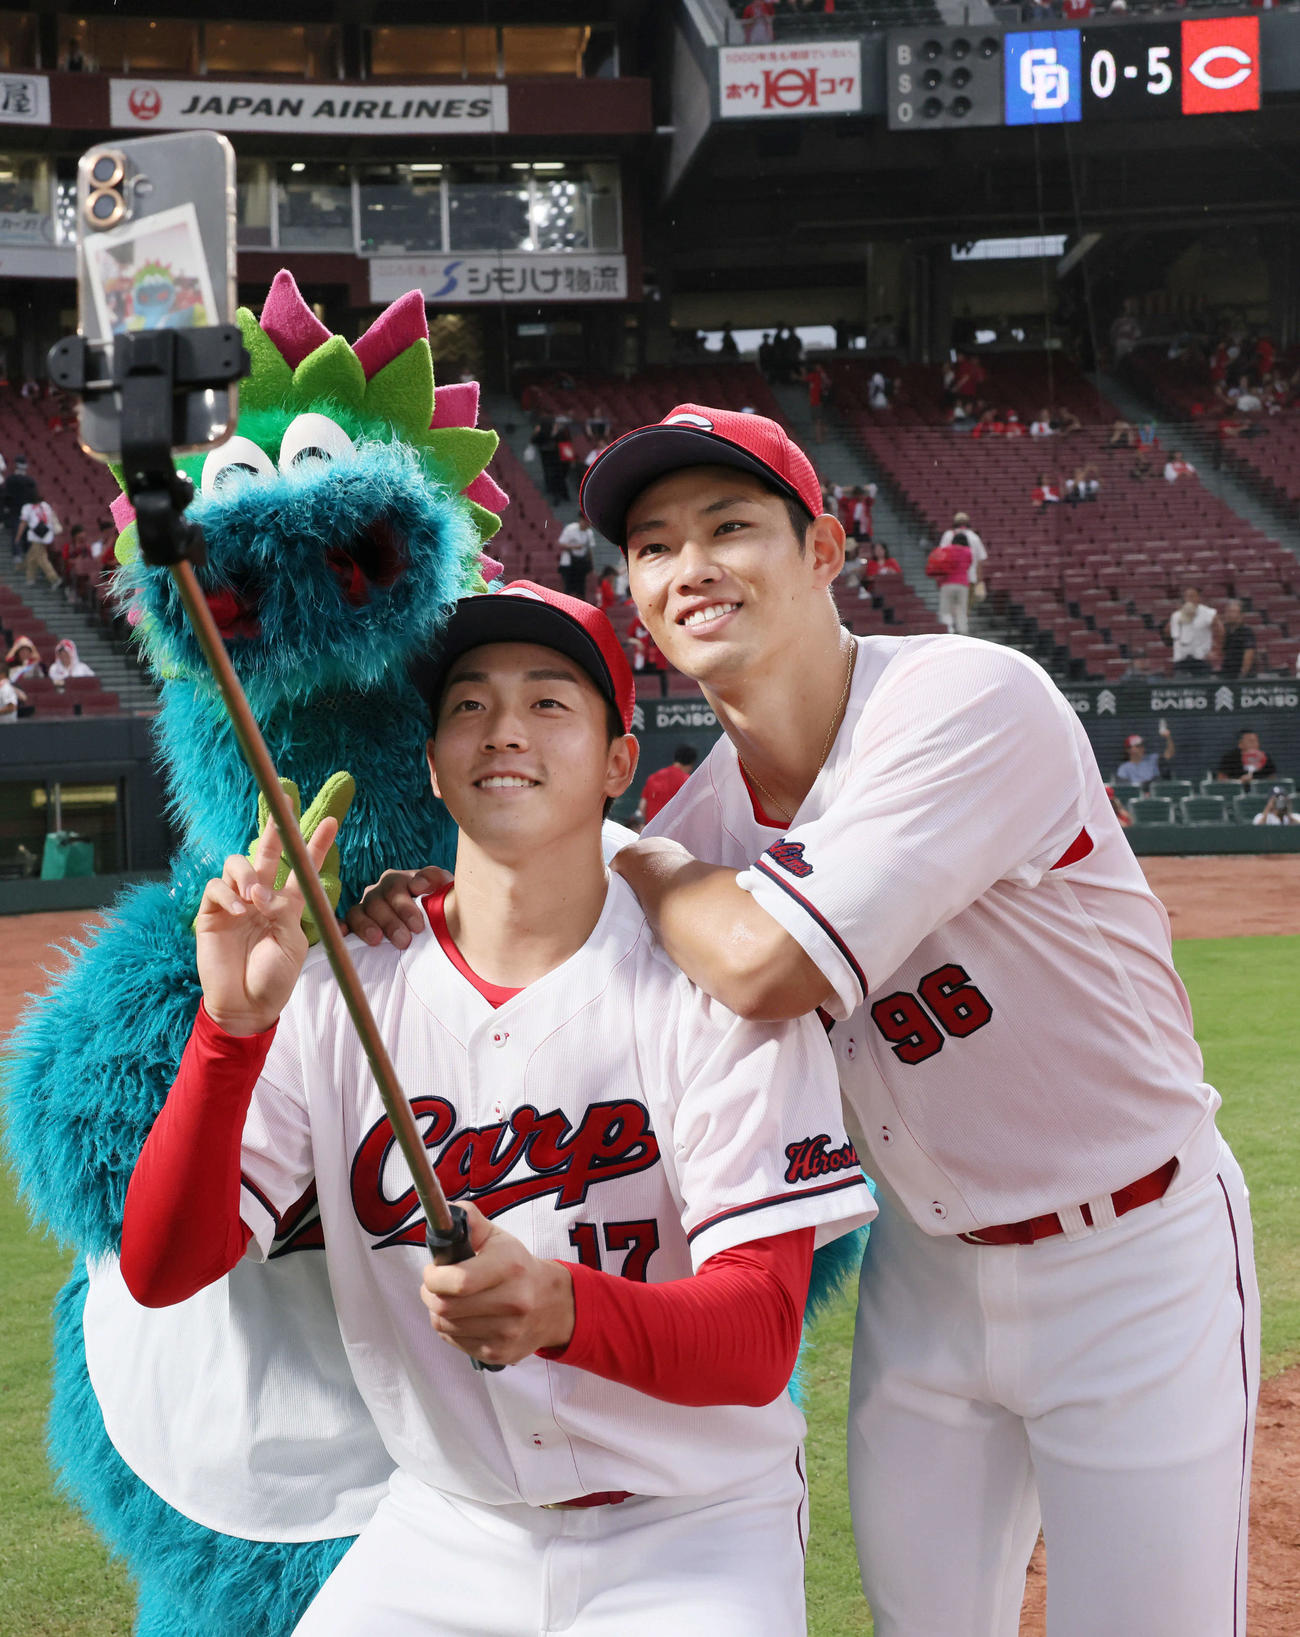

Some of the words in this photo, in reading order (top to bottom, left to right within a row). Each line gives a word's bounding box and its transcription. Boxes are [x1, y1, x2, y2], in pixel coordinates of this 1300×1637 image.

[897, 44, 912, 65] B
[898, 73, 912, 94] S
[181, 96, 304, 117] JAPAN
[312, 98, 492, 119] AIRLINES
[467, 266, 620, 294] シモハナ物流
[1151, 696, 1208, 711] DAISO
[1241, 694, 1299, 709] DAISO
[656, 711, 717, 728] DAISO
[871, 963, 993, 1066] 96
[350, 1095, 662, 1250] Carp
[568, 1218, 660, 1283] 17
